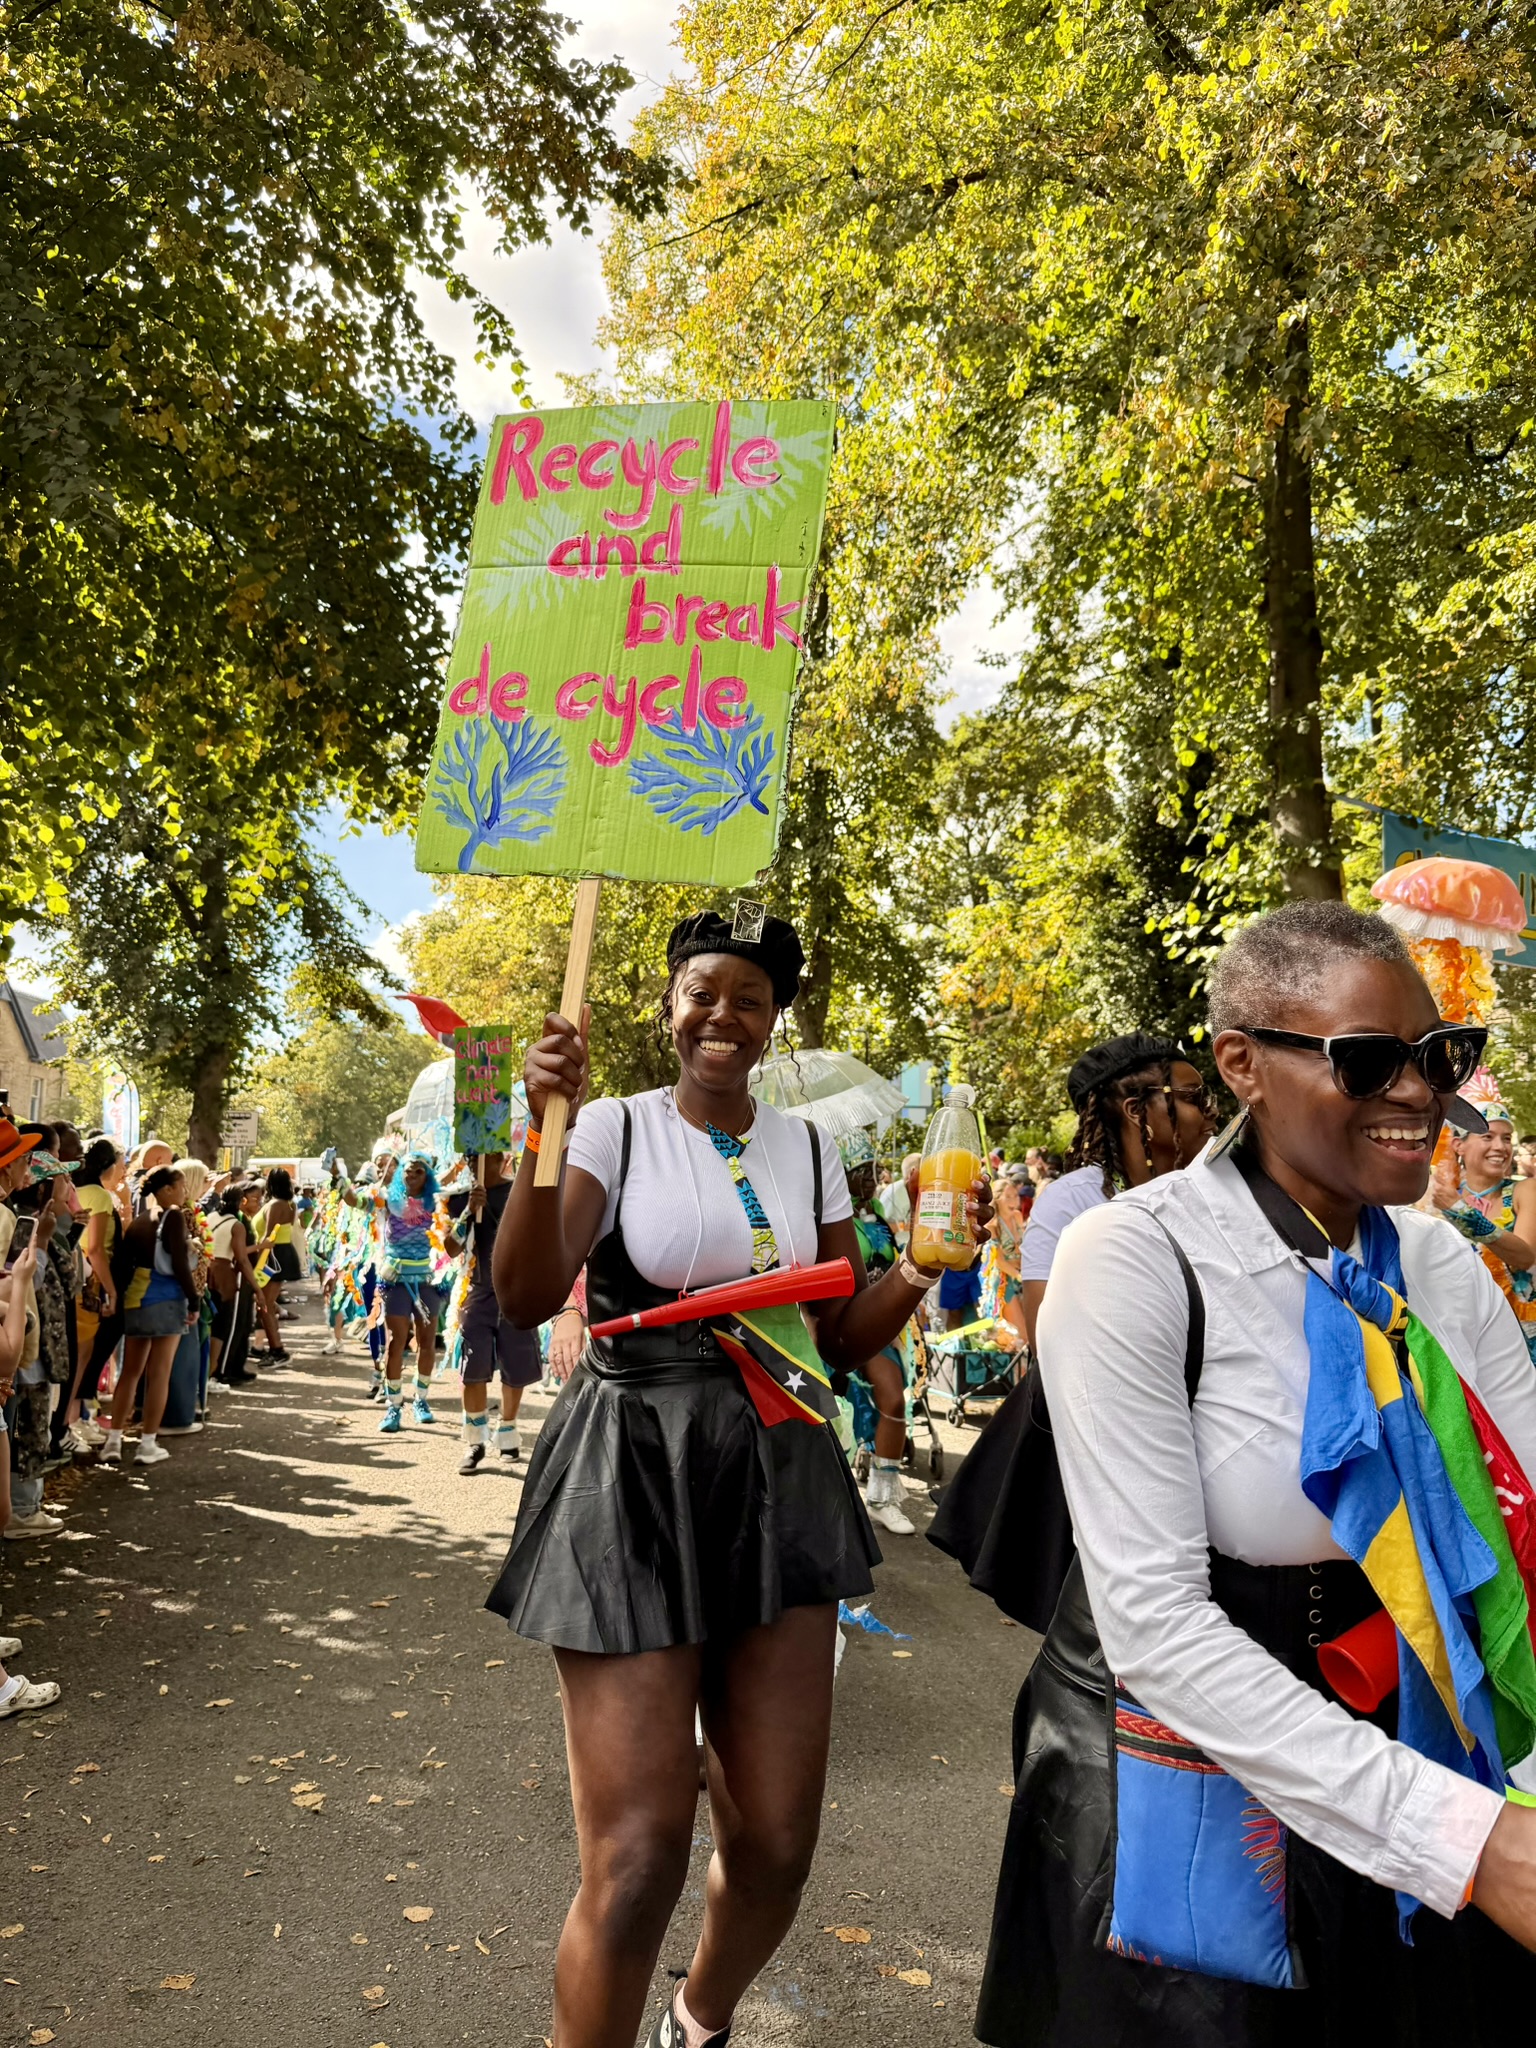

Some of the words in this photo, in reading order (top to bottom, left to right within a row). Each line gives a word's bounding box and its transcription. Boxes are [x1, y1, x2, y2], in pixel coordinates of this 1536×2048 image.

[490, 400, 783, 530] Recycle
[547, 502, 682, 580] and
[624, 562, 807, 651] break
[448, 642, 530, 722] de
[555, 644, 747, 767] cycle
[455, 1029, 511, 1059] climate
[466, 1055, 499, 1082] nah
[456, 1082, 501, 1104] wait
